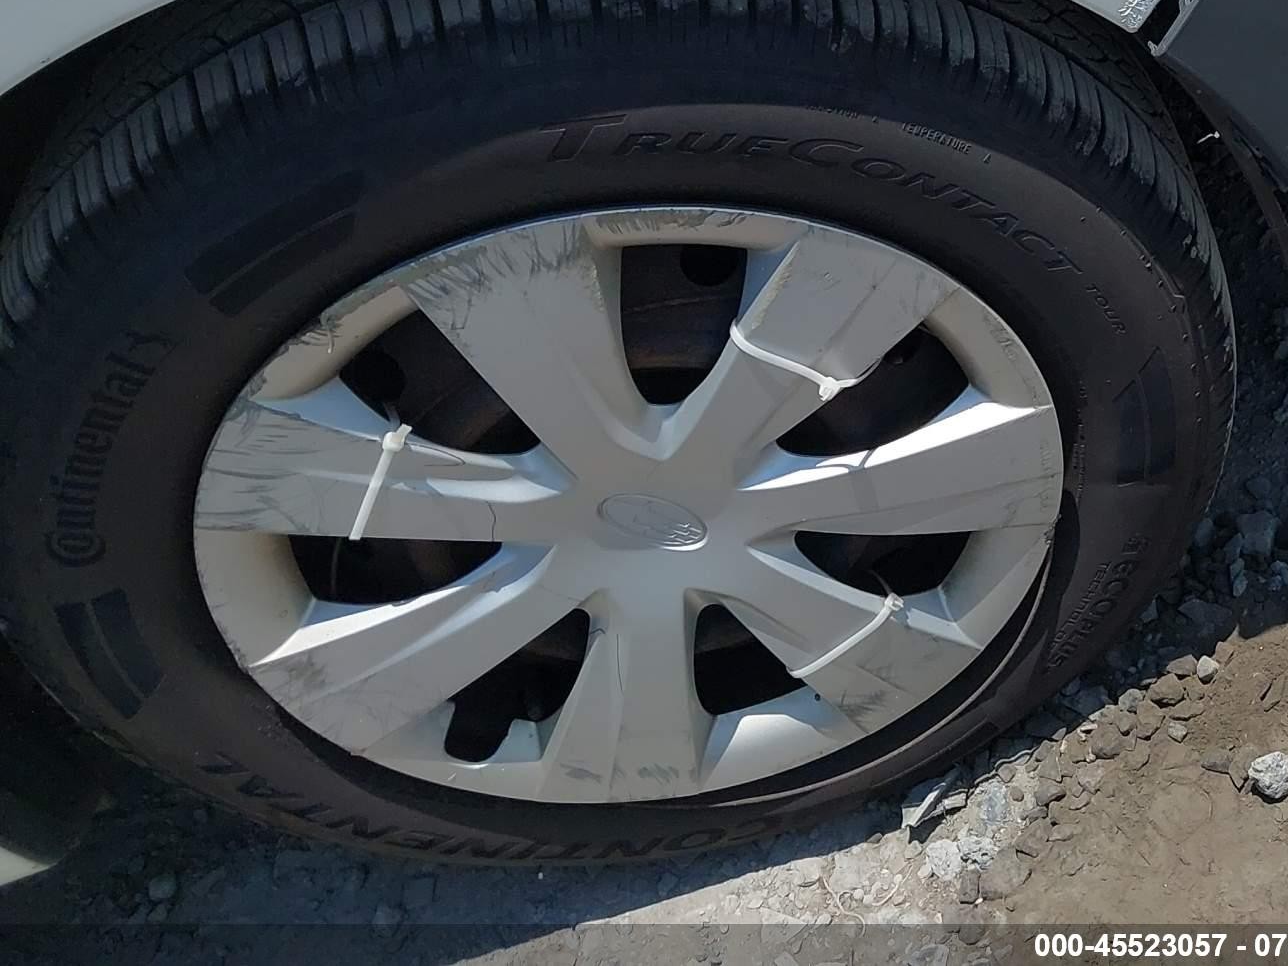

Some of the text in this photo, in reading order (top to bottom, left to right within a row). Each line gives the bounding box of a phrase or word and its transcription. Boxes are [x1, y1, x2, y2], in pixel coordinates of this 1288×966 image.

[1085, 282, 1127, 336] TOUR
[46, 351, 157, 568] Continental
[200, 752, 787, 862] CONTINENTAL
